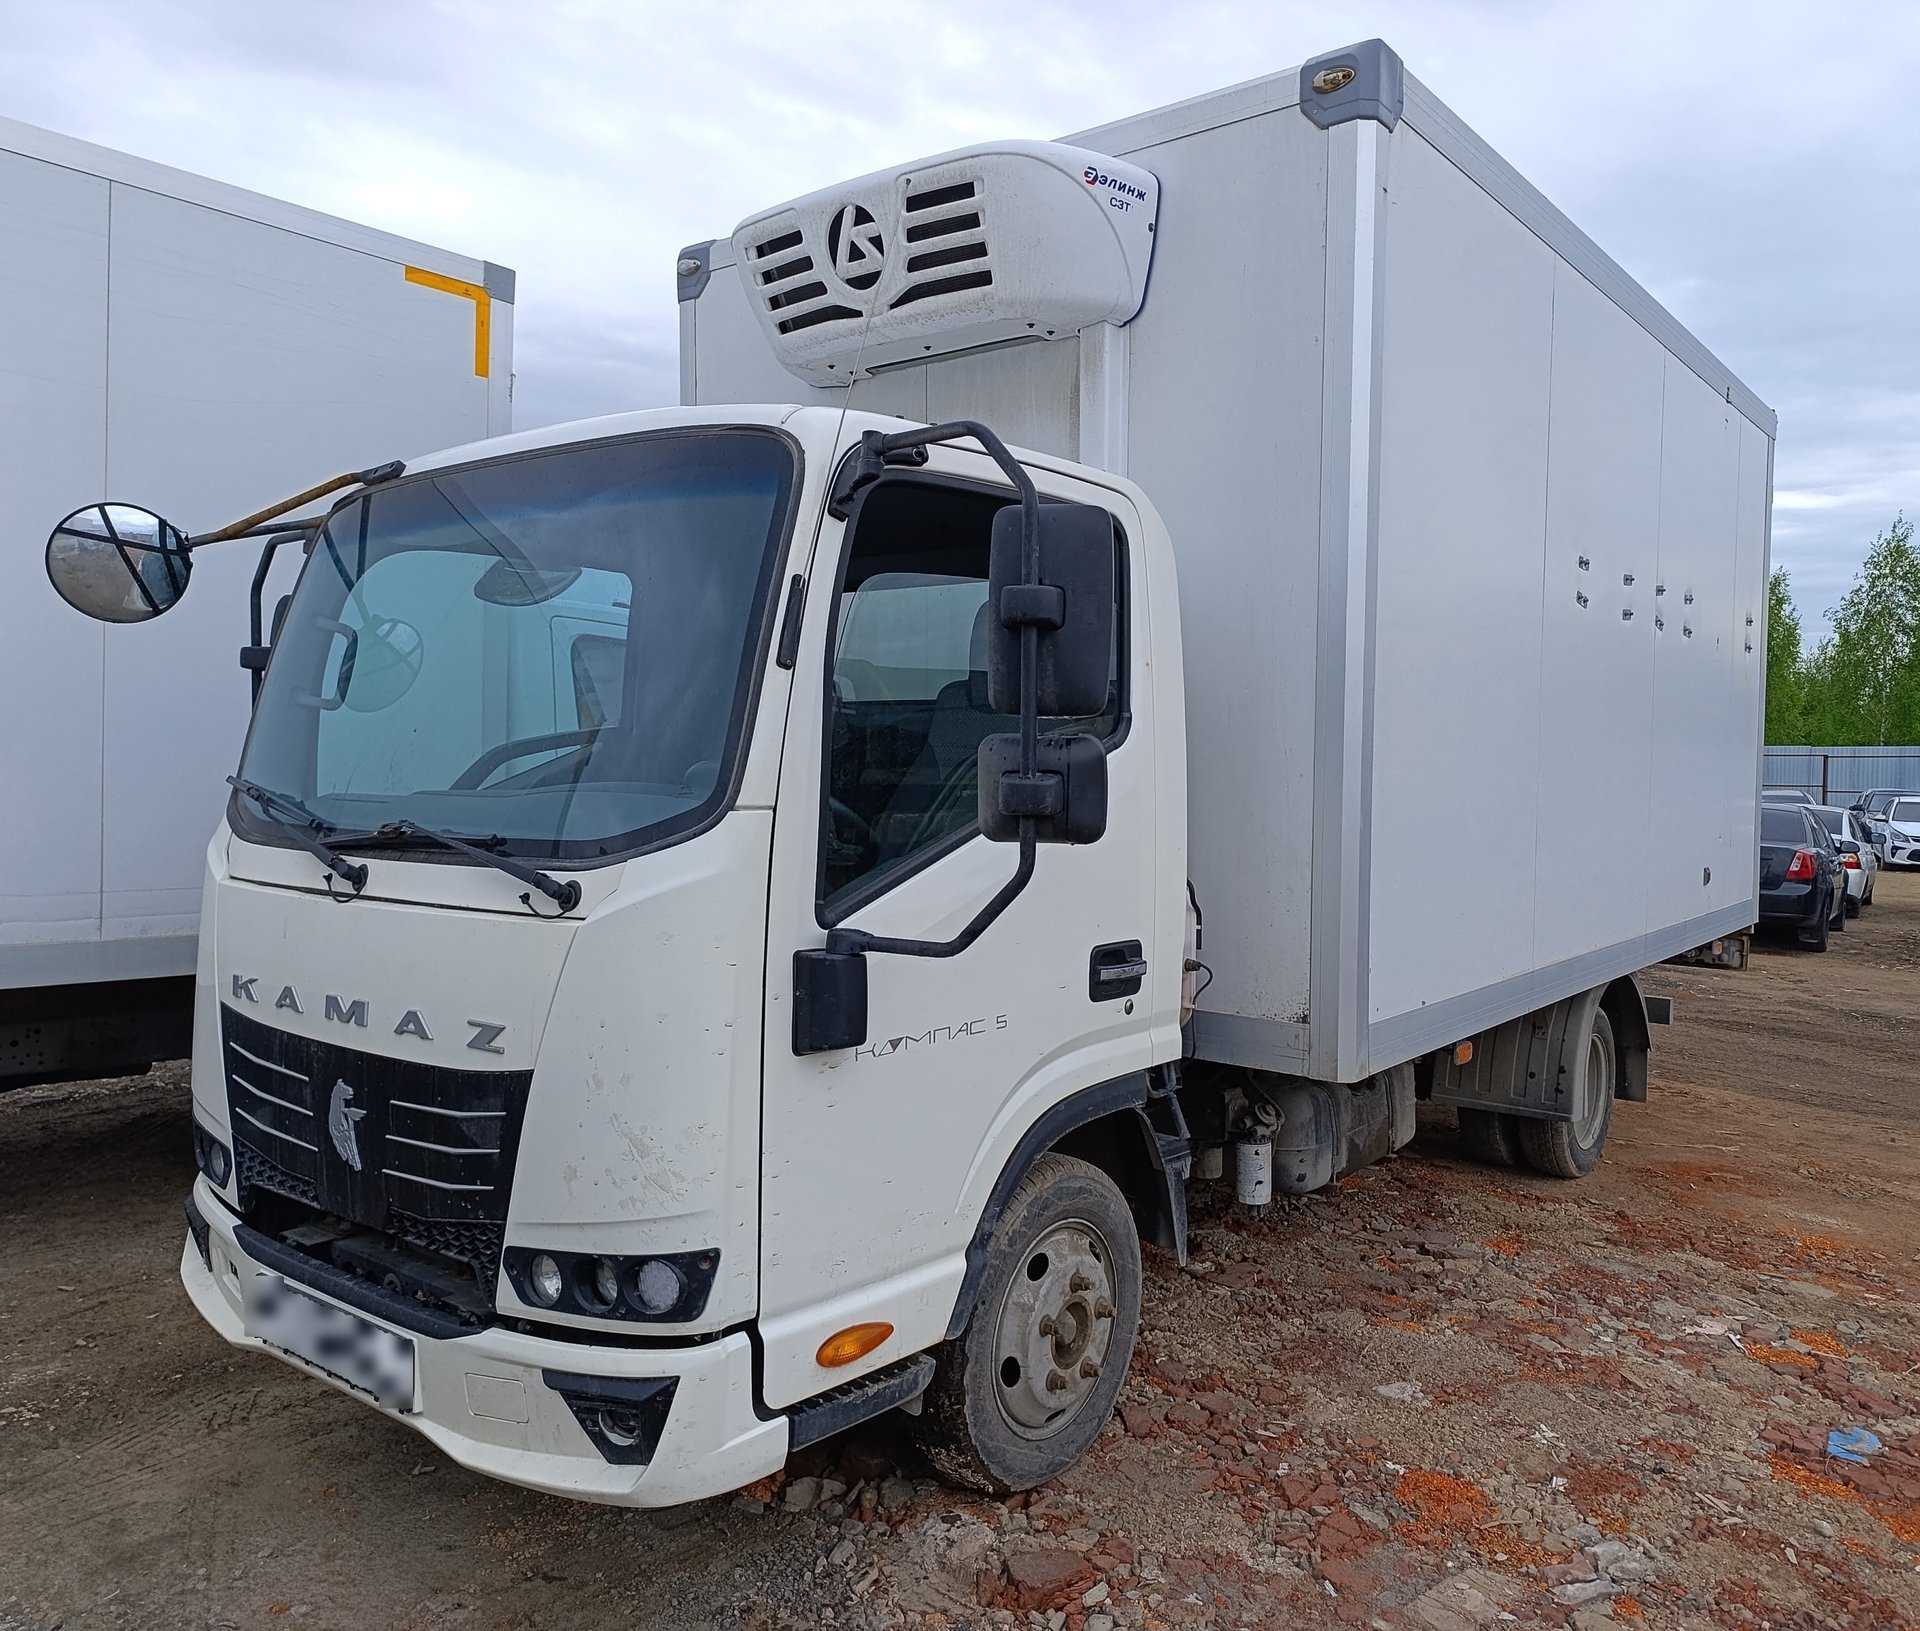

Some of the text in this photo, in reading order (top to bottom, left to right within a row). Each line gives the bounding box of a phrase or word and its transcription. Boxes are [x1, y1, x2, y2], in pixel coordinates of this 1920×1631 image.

[1099, 175, 1146, 201] ЭЛИНЖ
[232, 974, 507, 1054] KAMAZ
[996, 1014, 1008, 1030] 5
